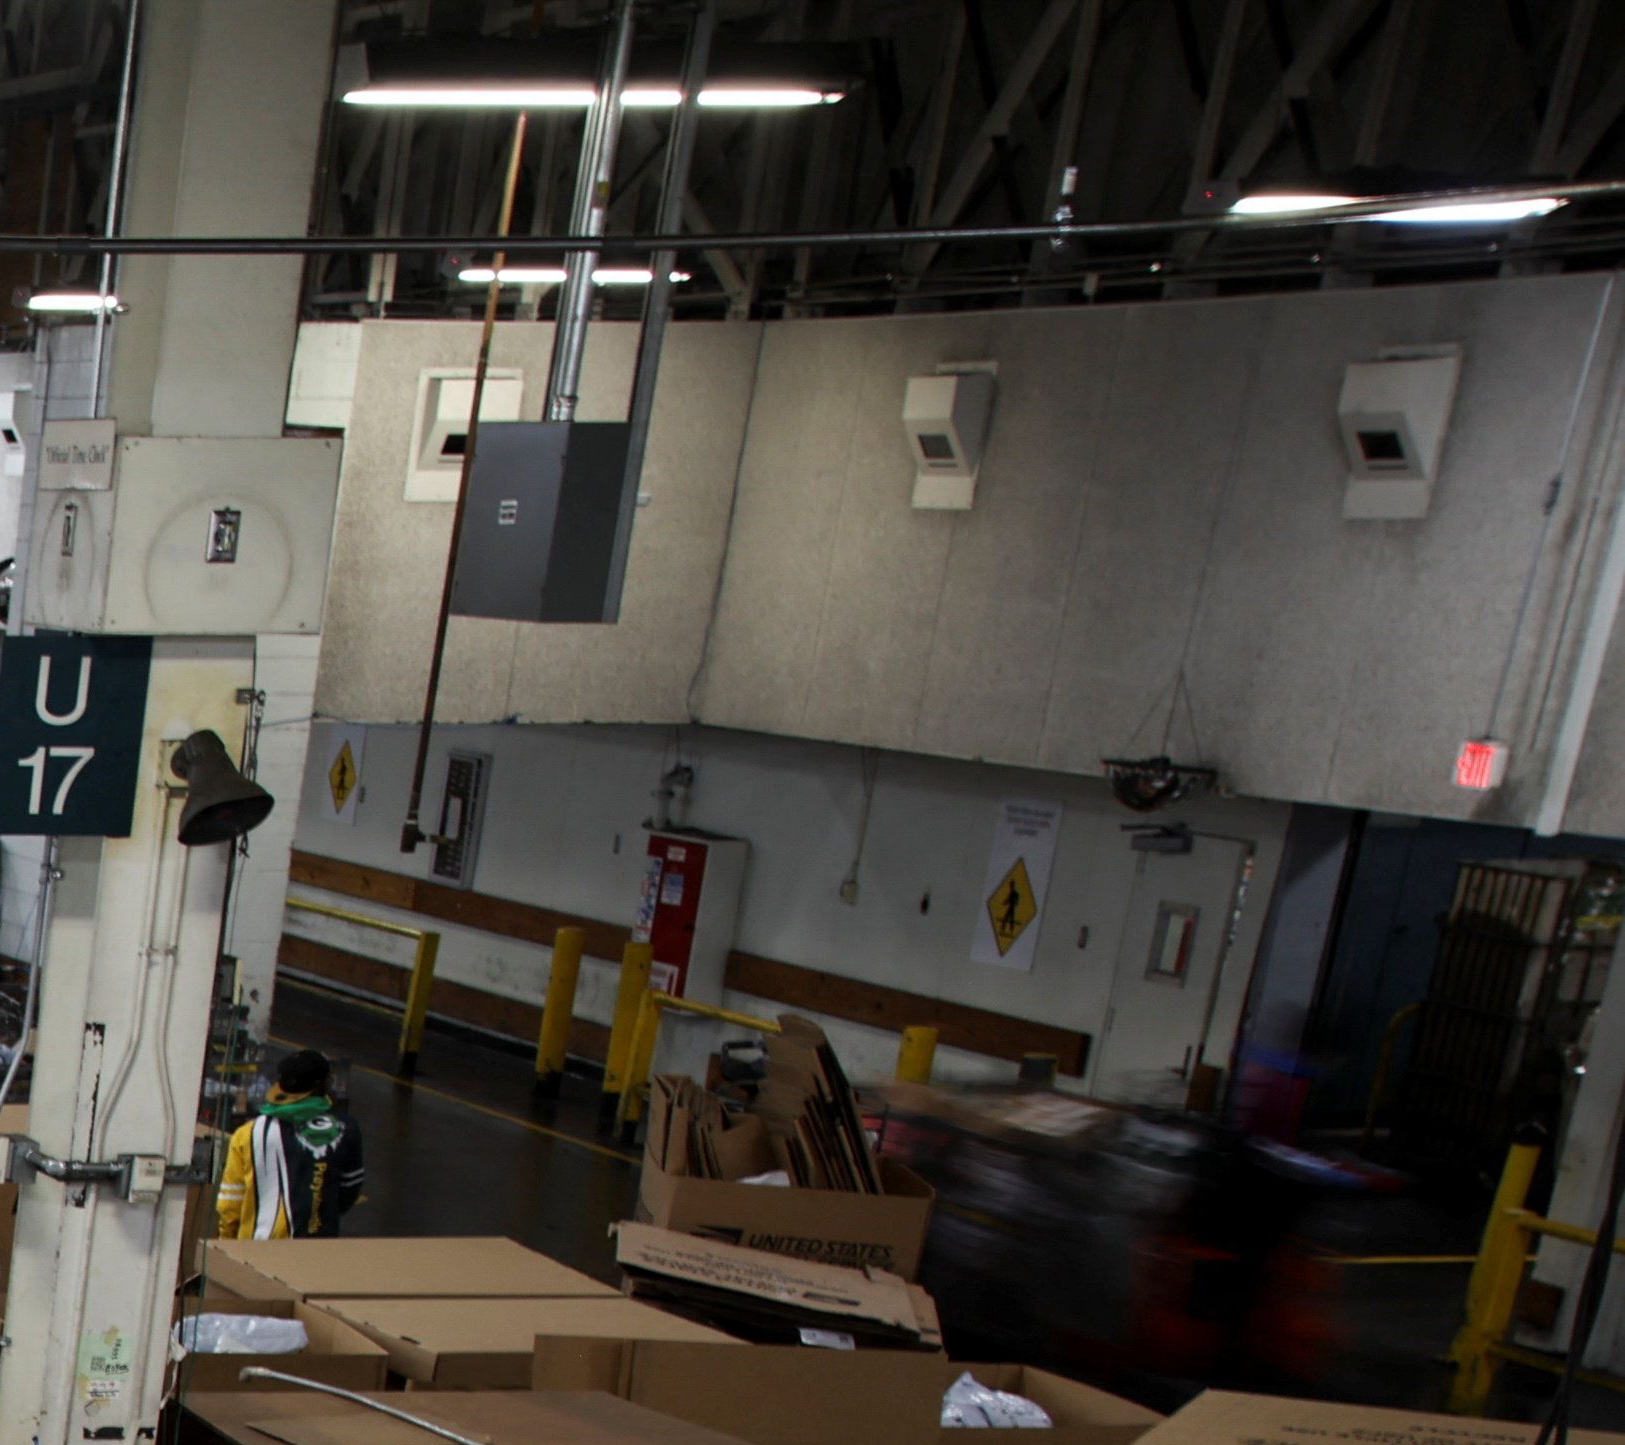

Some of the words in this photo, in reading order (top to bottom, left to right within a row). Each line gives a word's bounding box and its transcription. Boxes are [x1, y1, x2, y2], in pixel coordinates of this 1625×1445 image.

[35, 655, 91, 727] U
[18, 746, 95, 816] 17
[748, 1233, 823, 1253] UNITED
[825, 1240, 892, 1259] STATES
